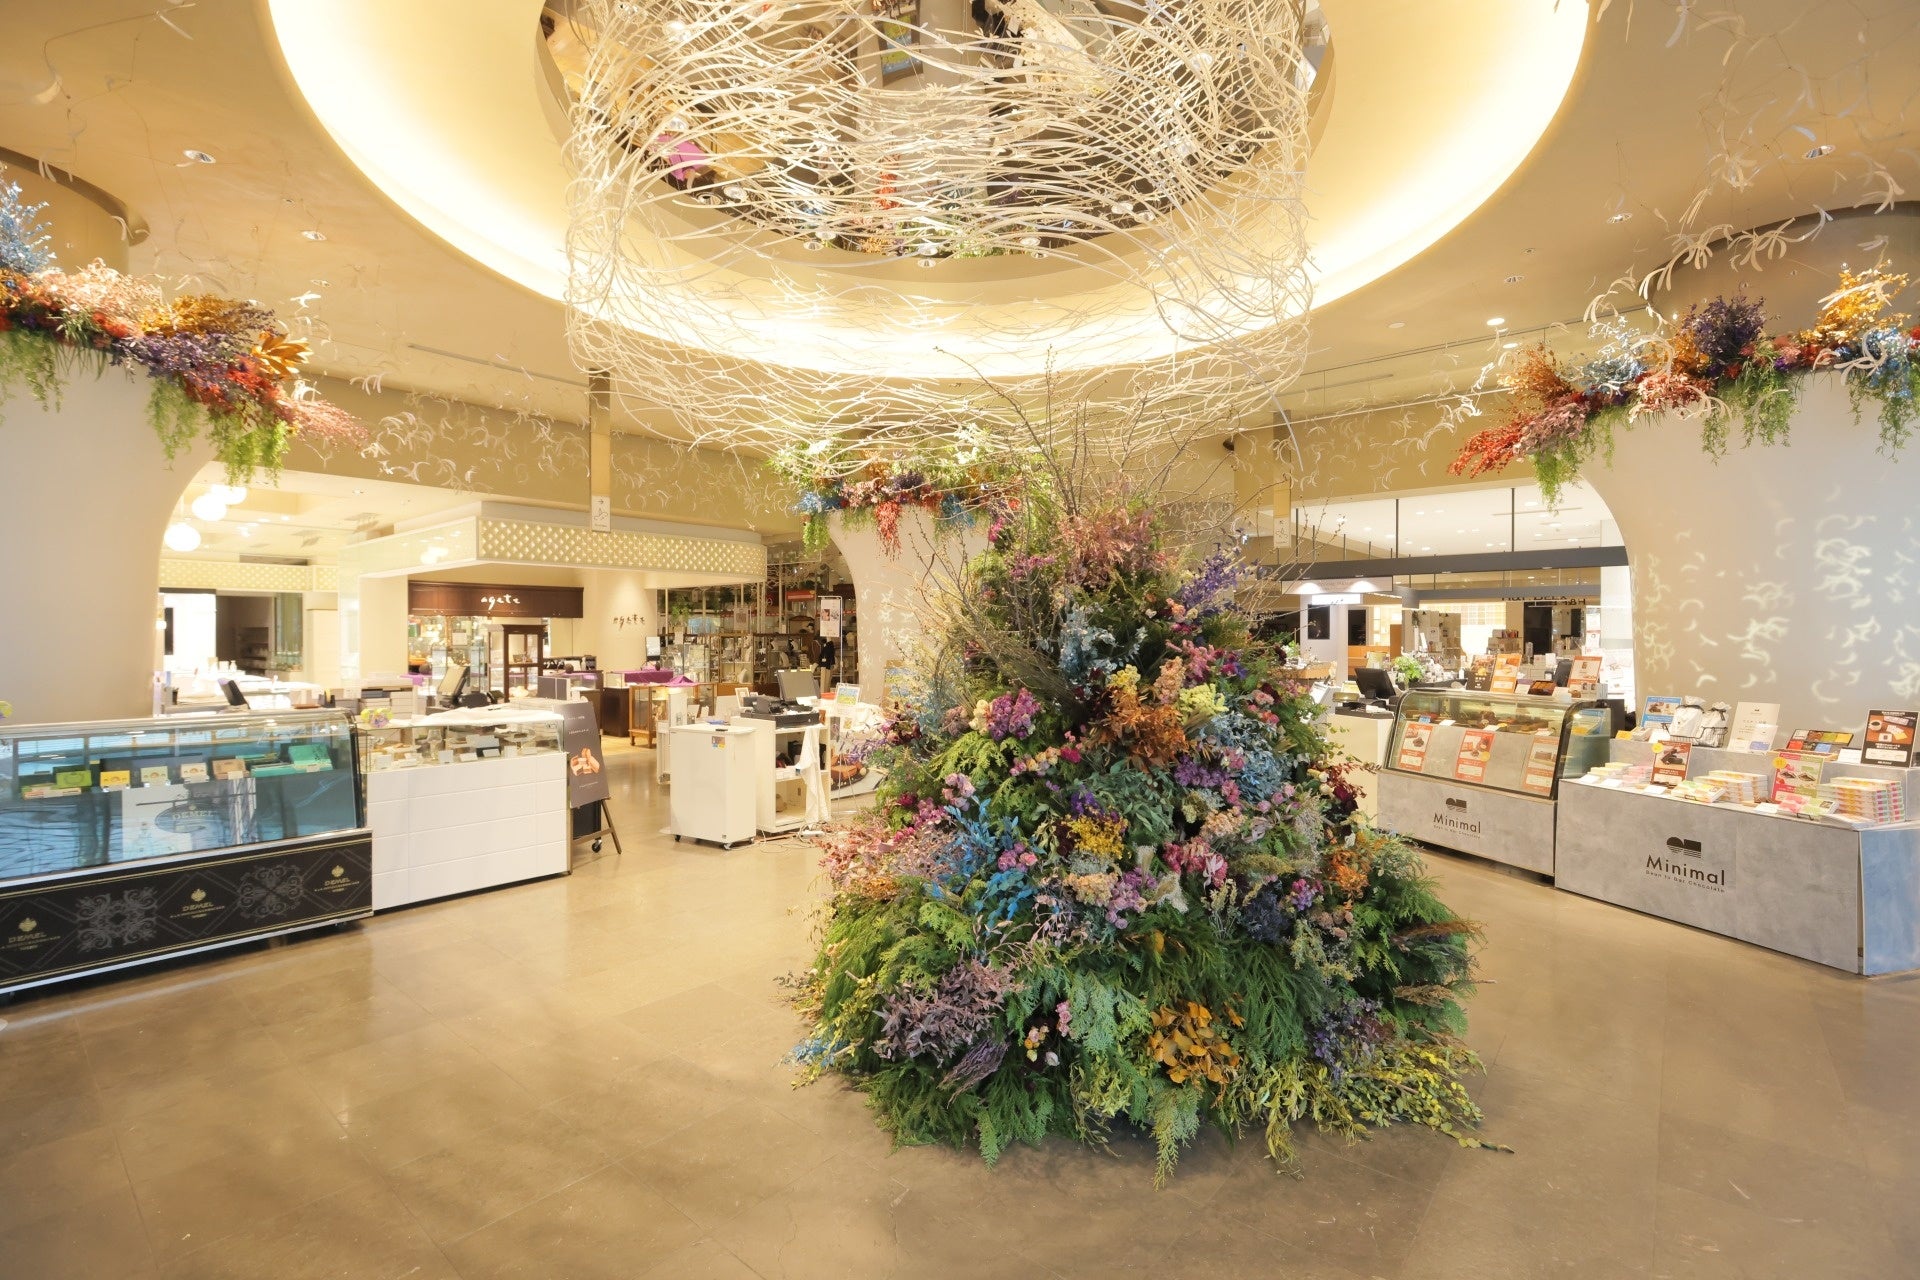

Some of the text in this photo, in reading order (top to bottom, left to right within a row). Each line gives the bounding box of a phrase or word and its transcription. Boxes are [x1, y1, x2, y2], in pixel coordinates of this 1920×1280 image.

[480, 594, 521, 611] agete
[613, 614, 645, 629] agete
[1433, 813, 1480, 833] Minimal
[1646, 855, 1724, 885] Minimal
[182, 902, 214, 911] DEMEL
